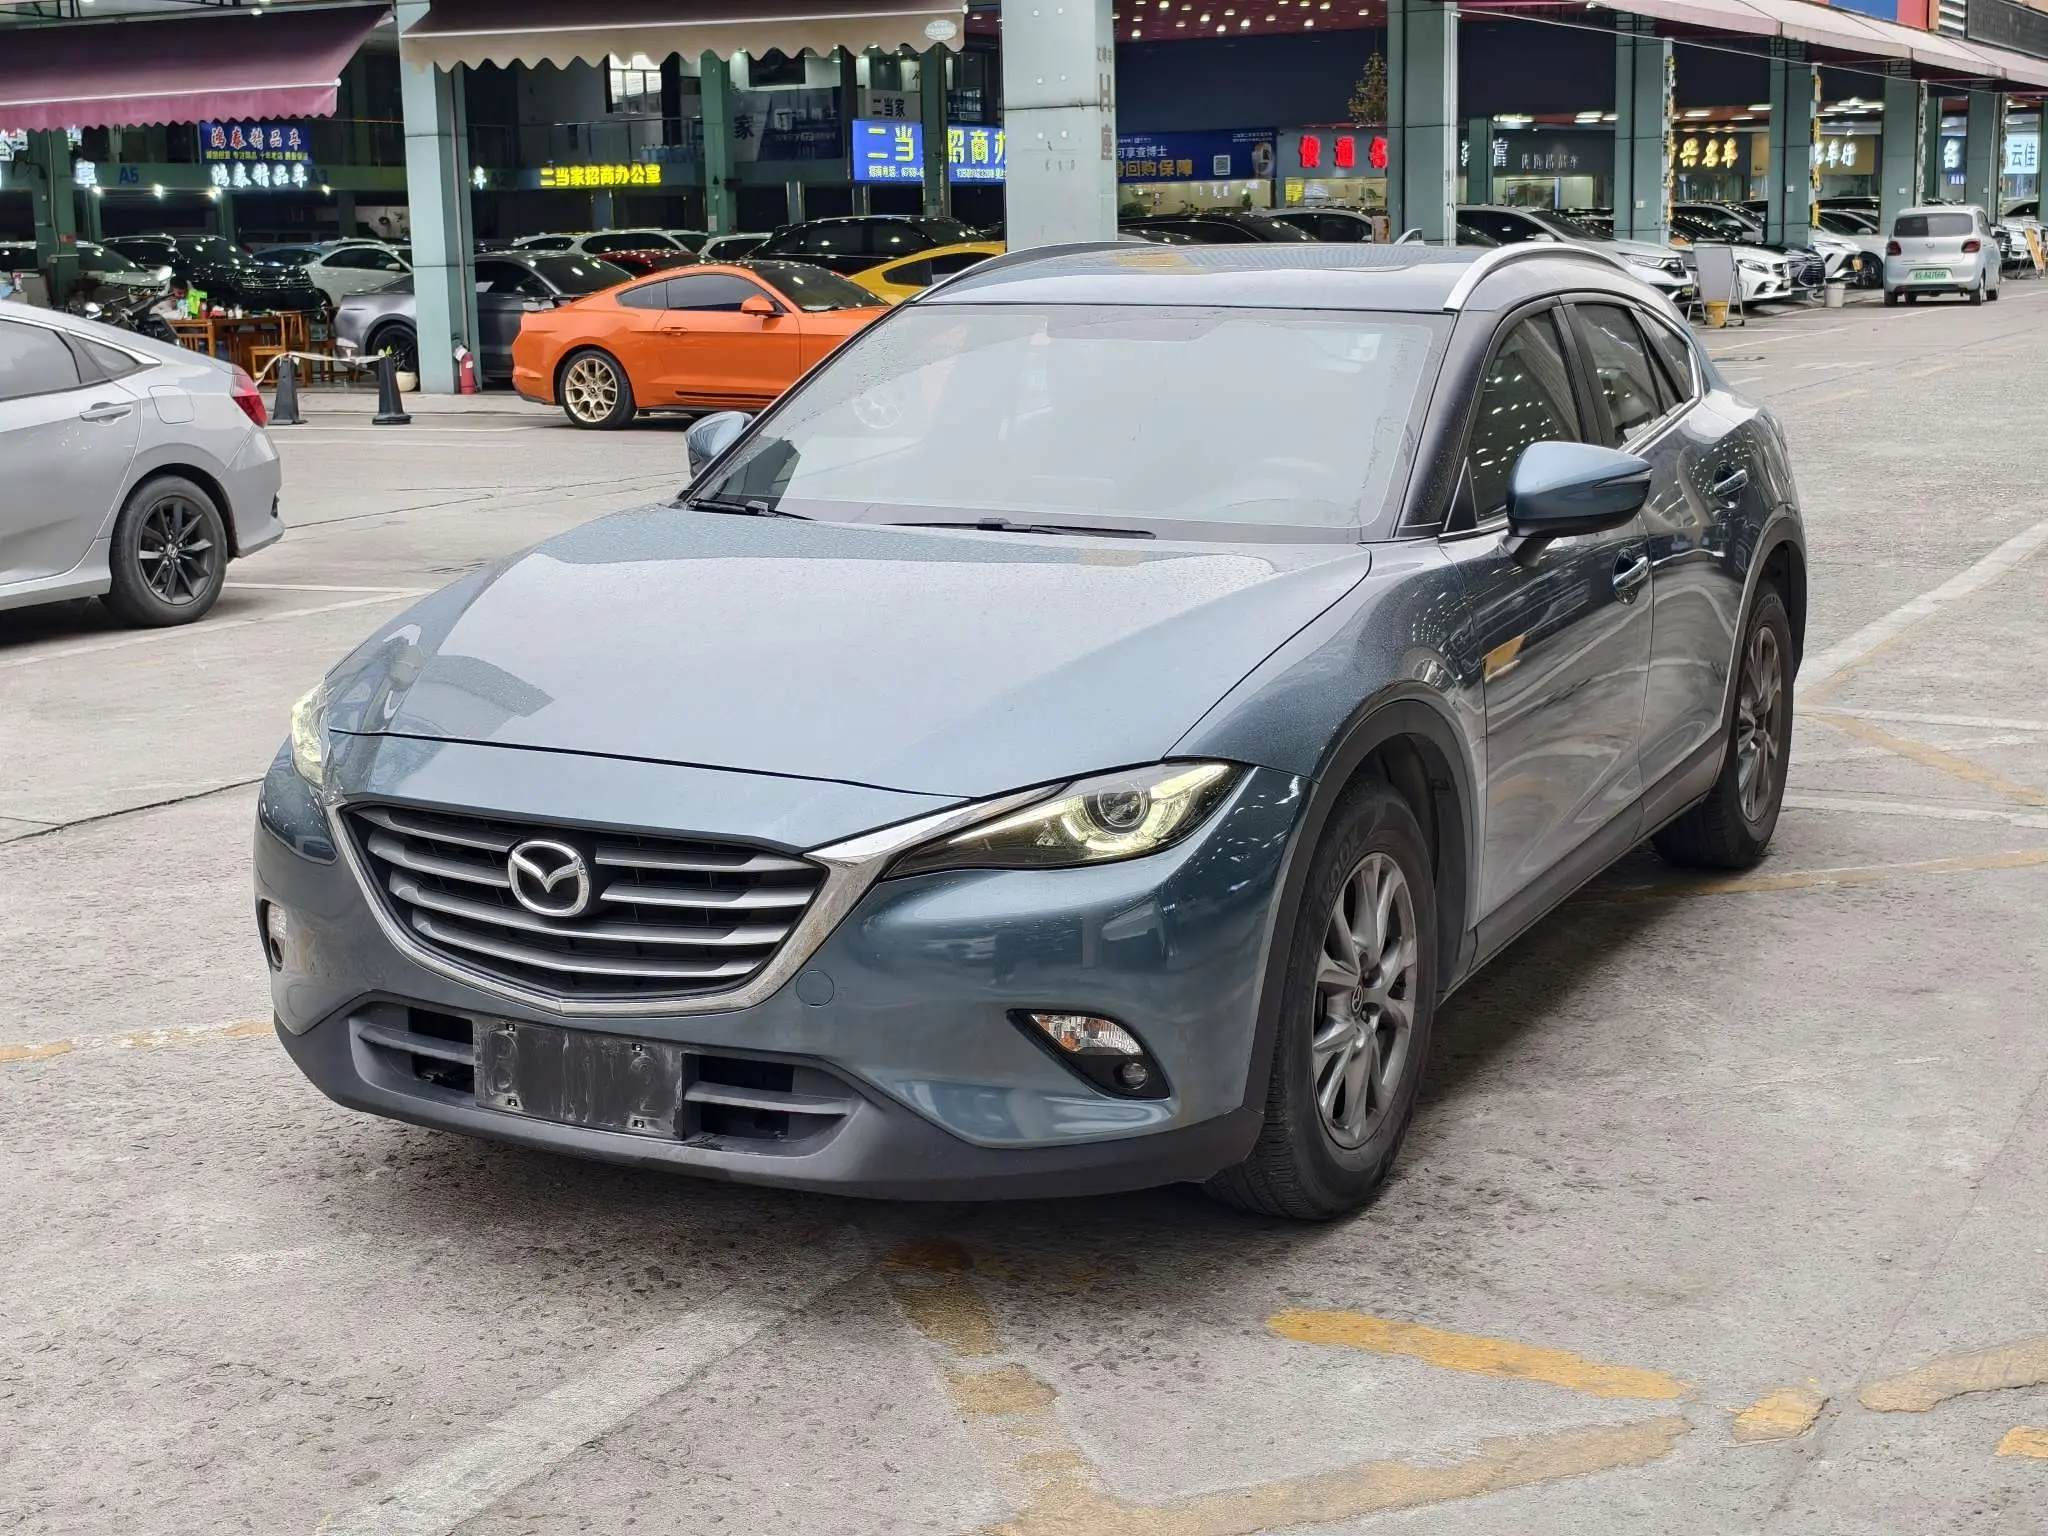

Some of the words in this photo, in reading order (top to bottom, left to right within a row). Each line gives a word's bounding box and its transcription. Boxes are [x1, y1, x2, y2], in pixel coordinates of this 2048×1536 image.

[867, 126, 914, 162] 二当
[540, 164, 661, 187] 二当家招商办公室
